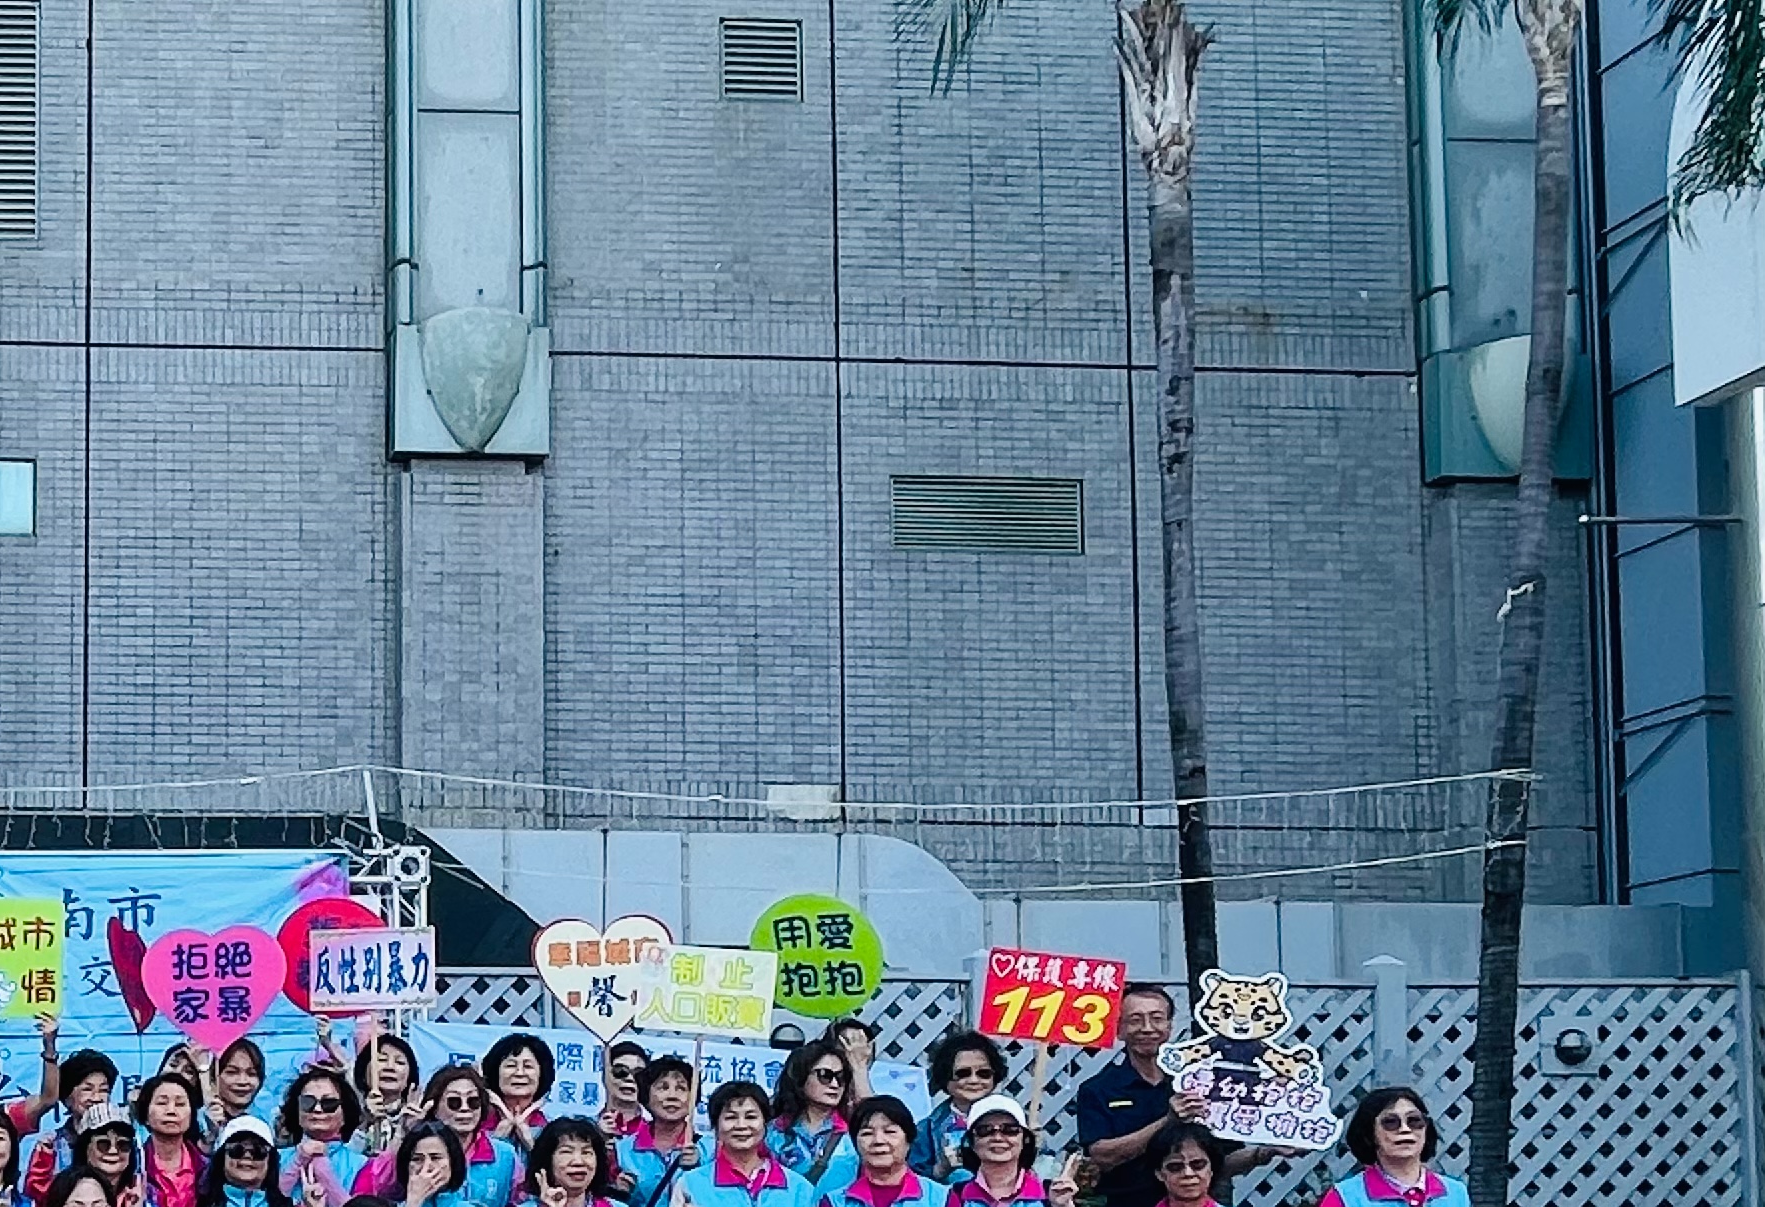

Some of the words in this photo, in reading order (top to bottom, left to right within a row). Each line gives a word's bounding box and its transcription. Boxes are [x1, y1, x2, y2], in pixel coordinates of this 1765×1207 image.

[772, 913, 854, 950] 用愛
[171, 941, 252, 981] 拒絕
[314, 939, 430, 996] 反性別暴力
[670, 952, 754, 990] 制止
[781, 961, 865, 998] 抱抱
[1015, 954, 1120, 993] 保護專線
[172, 986, 252, 1024] 家暴
[638, 987, 766, 1032] 人口販賣
[992, 986, 1111, 1043] 113
